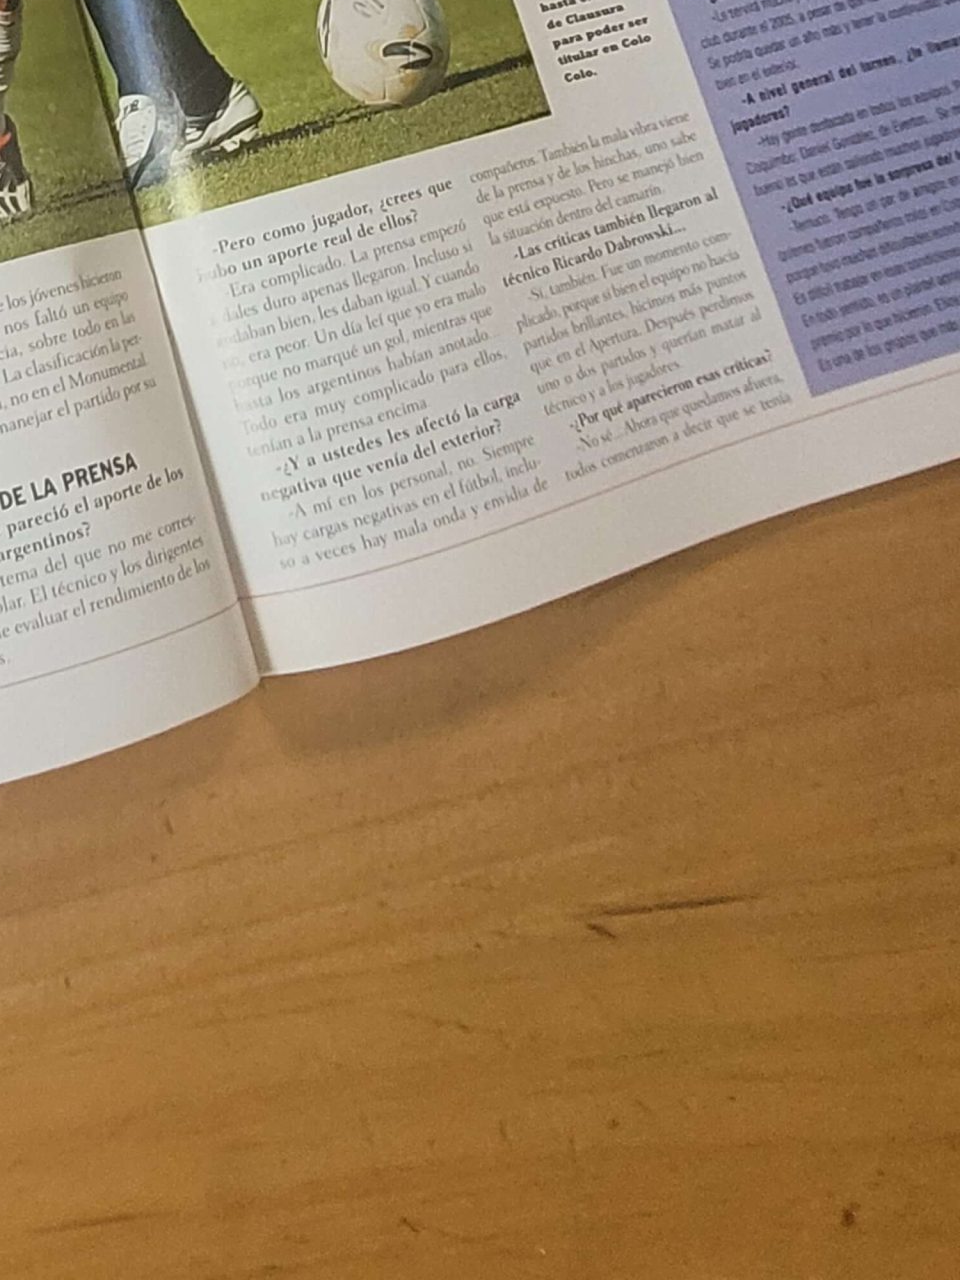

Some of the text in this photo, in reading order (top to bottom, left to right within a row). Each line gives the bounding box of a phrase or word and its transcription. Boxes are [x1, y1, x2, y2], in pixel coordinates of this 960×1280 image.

[546, 4, 624, 30] de Clausura
[551, 16, 648, 51] para poder ser
[557, 34, 652, 66] titular en Colo
[563, 68, 598, 83] Colo.
[213, 180, 452, 254] -Pero como jugador, ¿crees que
[513, 186, 719, 260] -Las críticas también llegaron al
[502, 222, 686, 288] técnico Ricardo Dabrowski...
[275, 392, 521, 478] -¿Y a ustedes les afectó la carga
[331, 467, 361, 488] que
[366, 451, 409, 474] venía
[413, 439, 437, 460] del
[440, 418, 501, 451] exterior?
[6, 502, 69, 539] pareció
[74, 495, 90, 514] el
[93, 483, 142, 509] aporte
[146, 472, 162, 490] de
[163, 467, 184, 484] los
[29, 478, 58, 501] LA
[61, 454, 138, 491] PRENSA
